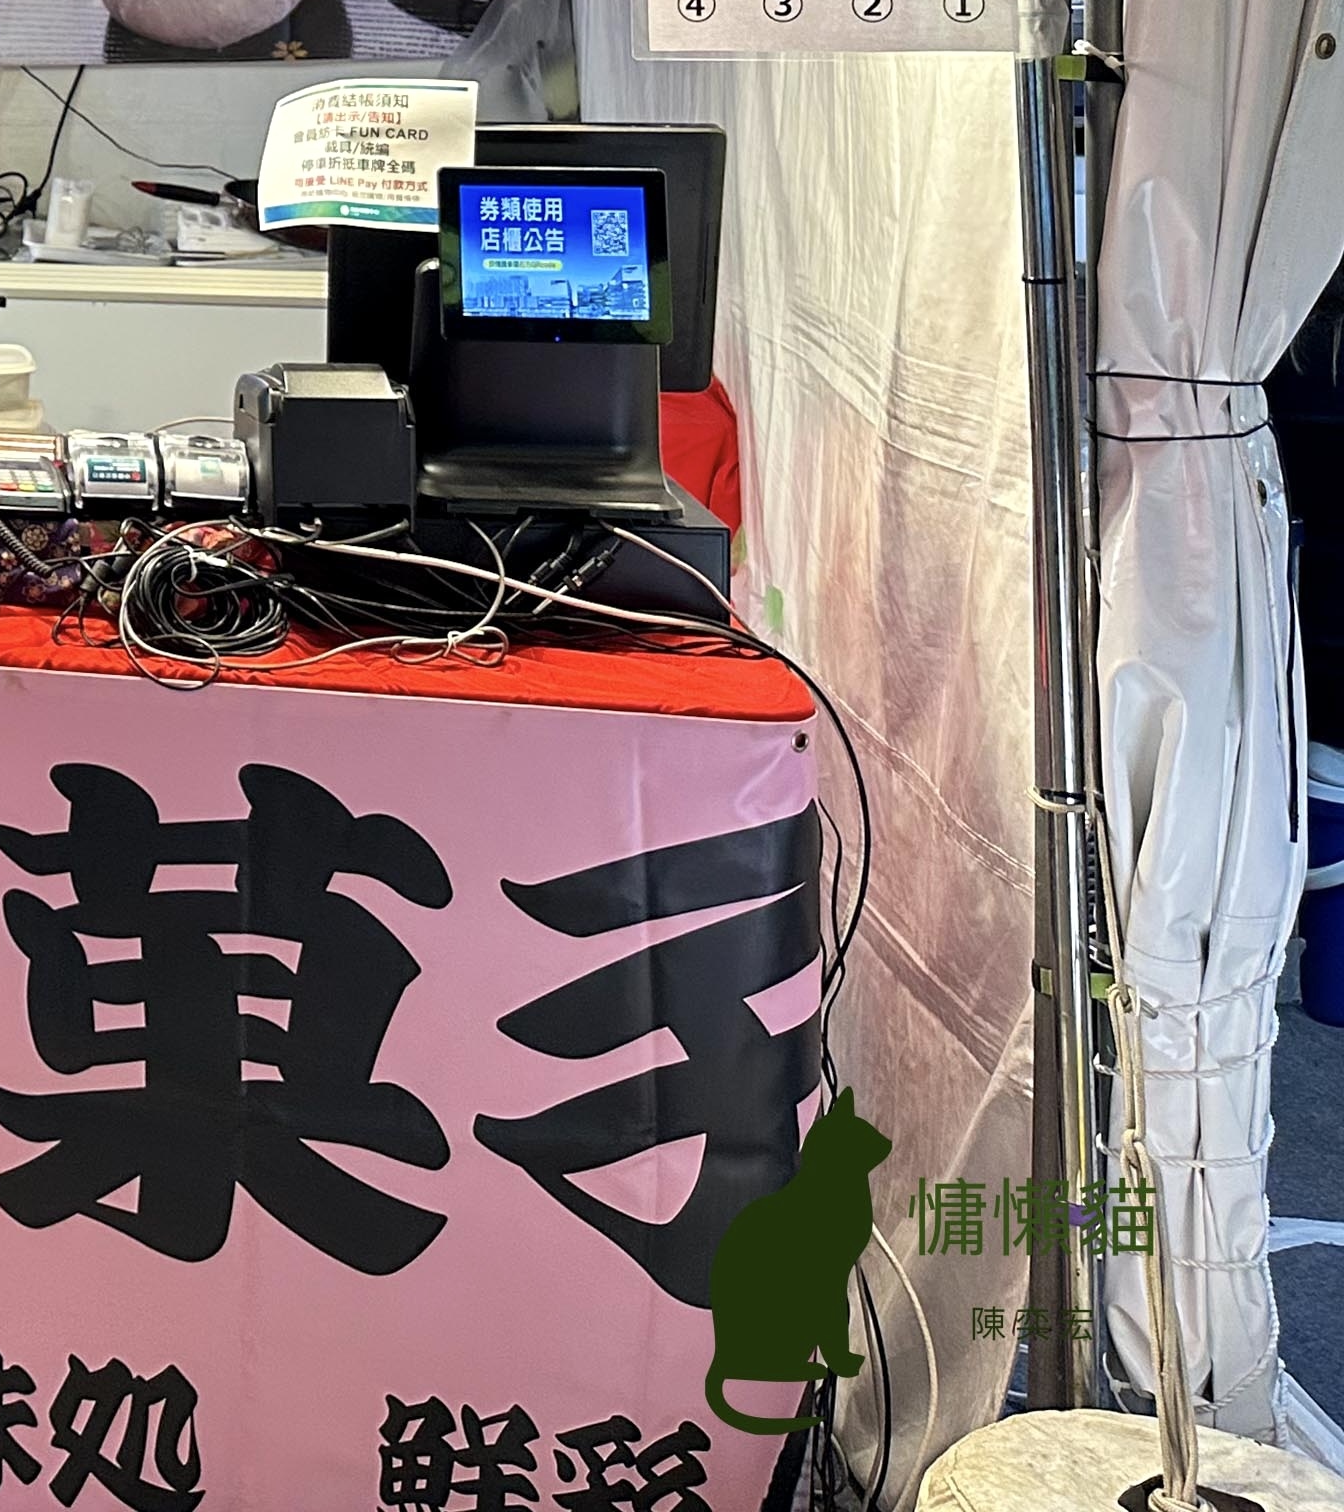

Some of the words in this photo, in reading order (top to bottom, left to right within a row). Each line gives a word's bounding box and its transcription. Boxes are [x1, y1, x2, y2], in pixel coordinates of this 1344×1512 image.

[350, 126, 381, 139] FUN
[385, 127, 429, 141] CARD
[358, 178, 378, 190] Pay
[479, 196, 564, 223] 券類使用
[480, 226, 565, 254] 店櫃公告
